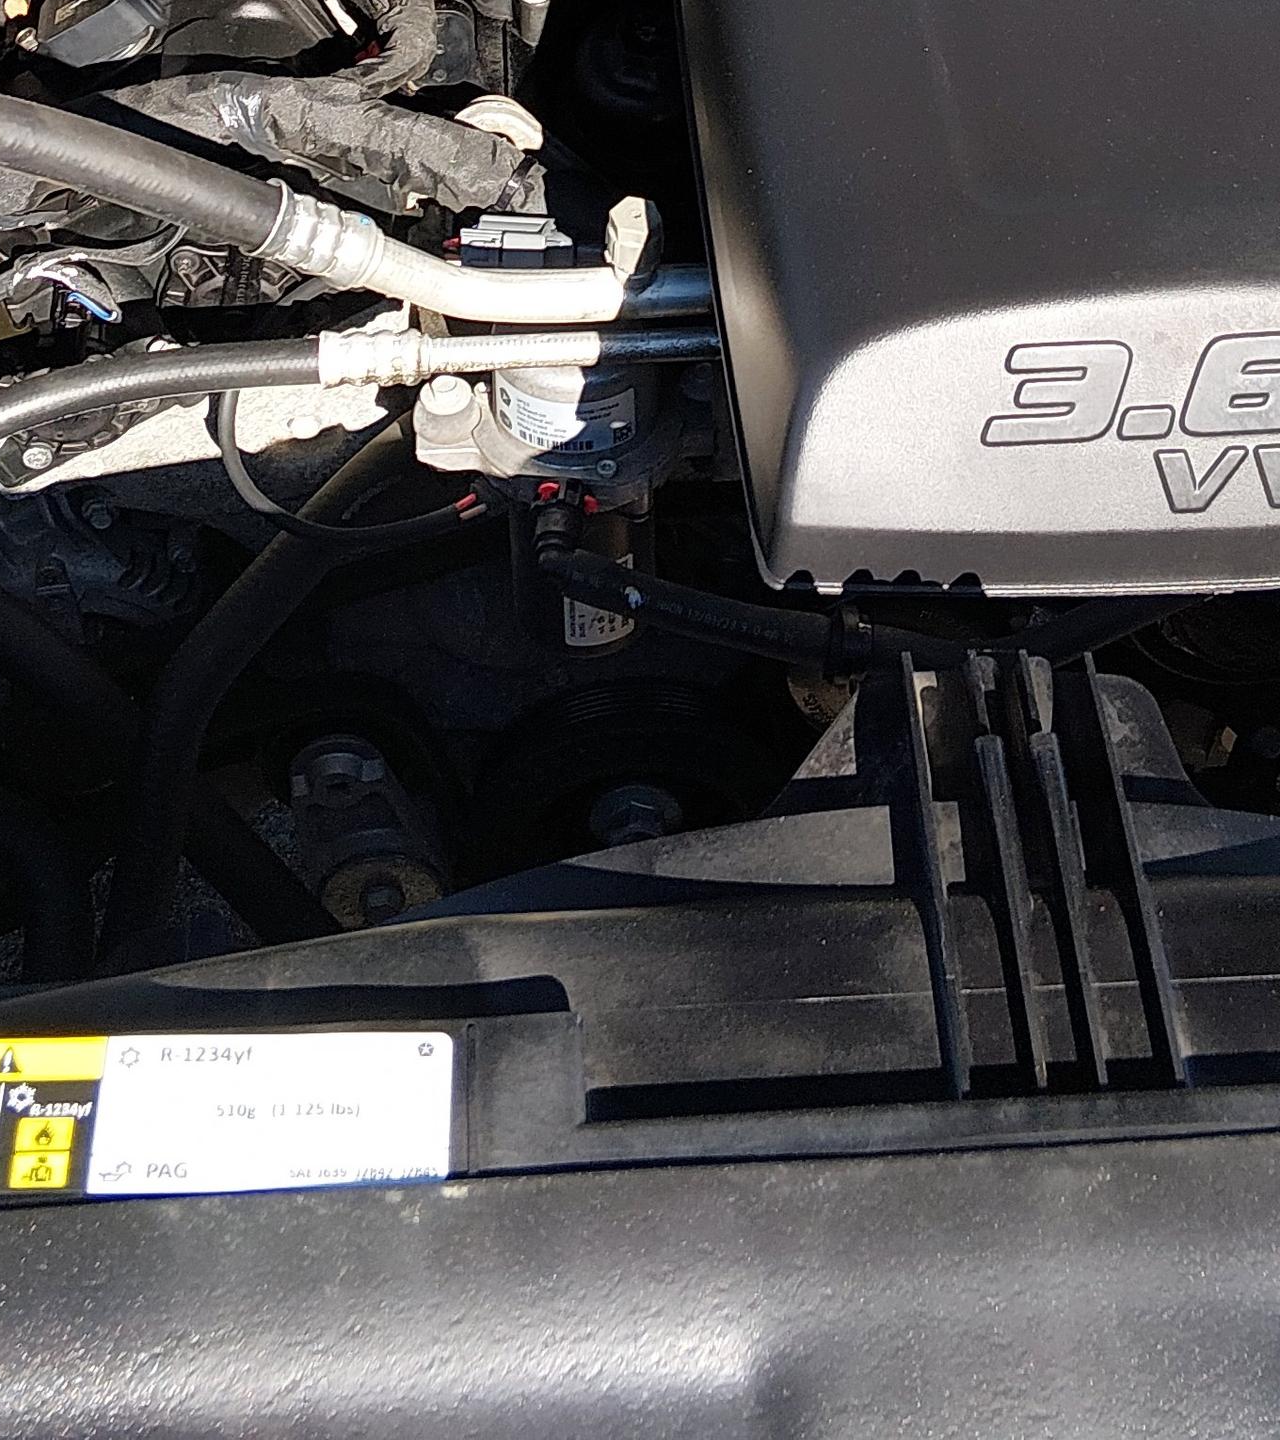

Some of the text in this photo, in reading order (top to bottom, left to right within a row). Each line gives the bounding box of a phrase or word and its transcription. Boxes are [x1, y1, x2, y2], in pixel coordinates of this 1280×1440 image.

[160, 1046, 254, 1066] R-1234yf
[215, 1103, 257, 1119] 510g
[146, 1162, 189, 1180] PAG
